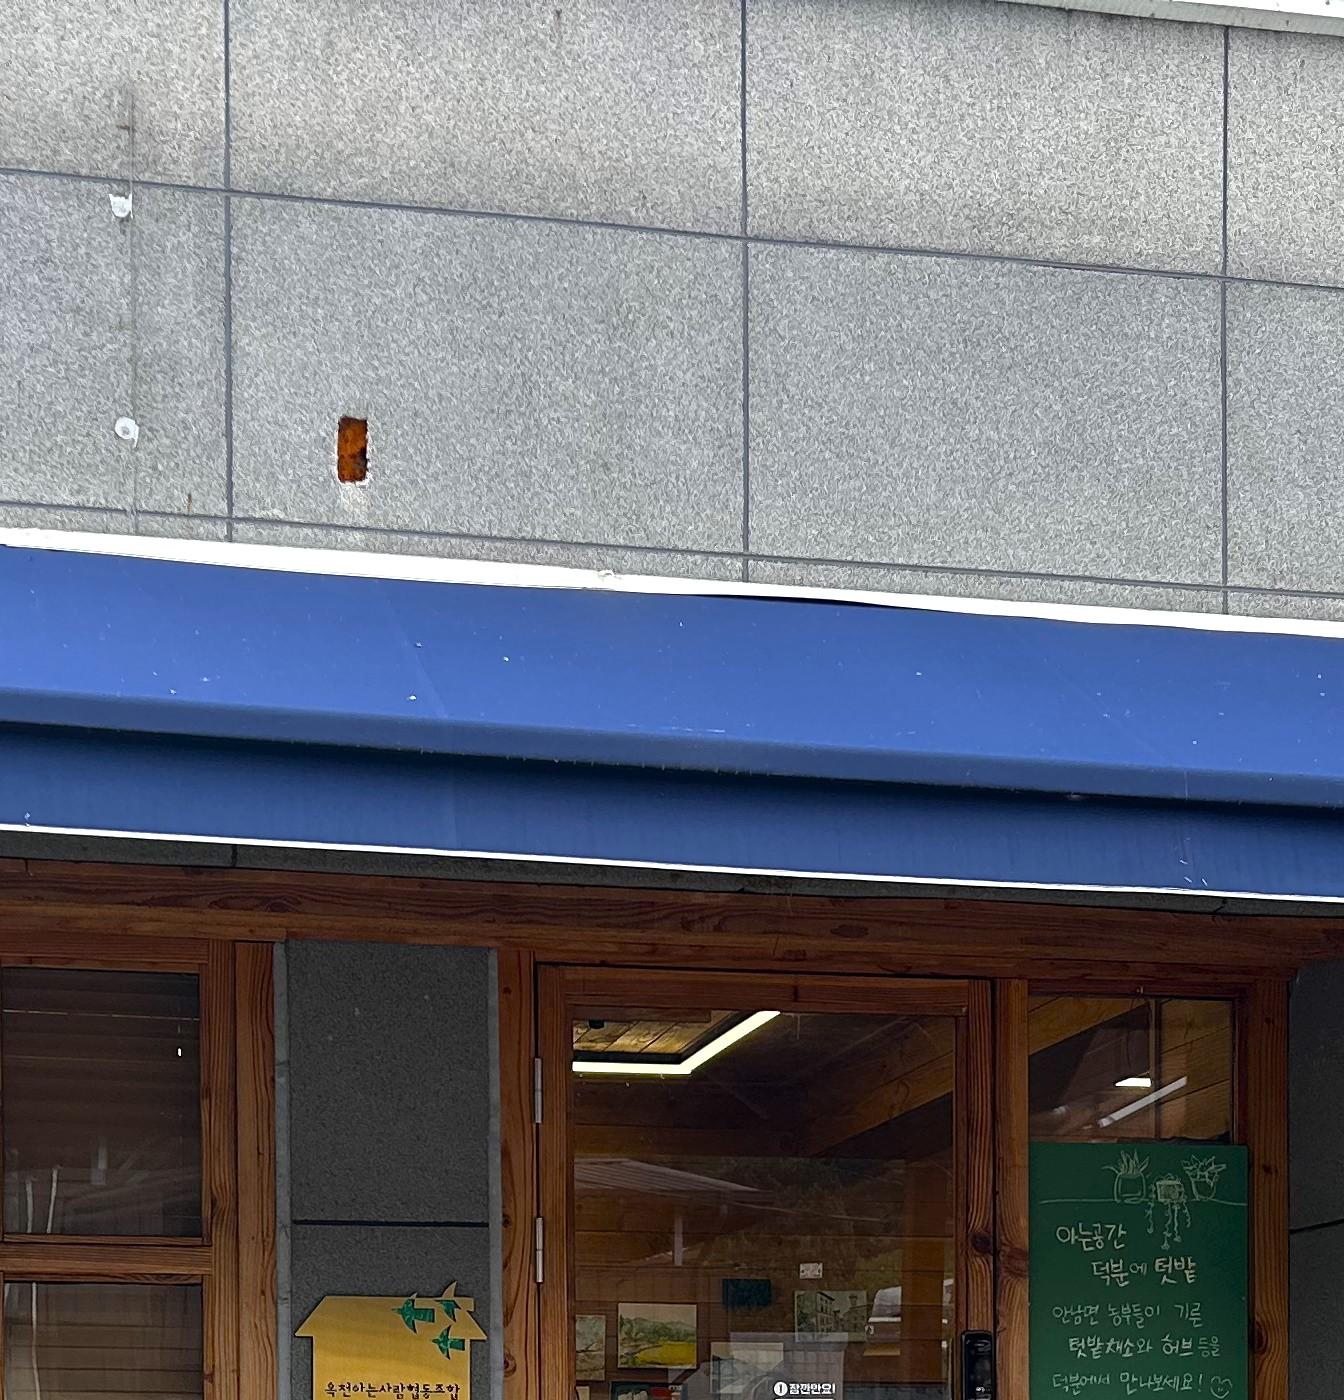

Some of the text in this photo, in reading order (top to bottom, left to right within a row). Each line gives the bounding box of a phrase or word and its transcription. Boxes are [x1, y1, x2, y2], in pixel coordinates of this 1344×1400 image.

[1056, 1223, 1127, 1251] 아는공간
[1091, 1257, 1198, 1287] 덕분에 텃밭
[1052, 1302, 1203, 1329] 안남면 농부들이 기른
[1161, 1333, 1194, 1358] 허브
[324, 1382, 460, 1400] 옥천아는사람협동조합
[789, 1383, 836, 1395] 잠깐만요!
[1052, 1371, 1204, 1396] 덕분에서 만나보세요!
